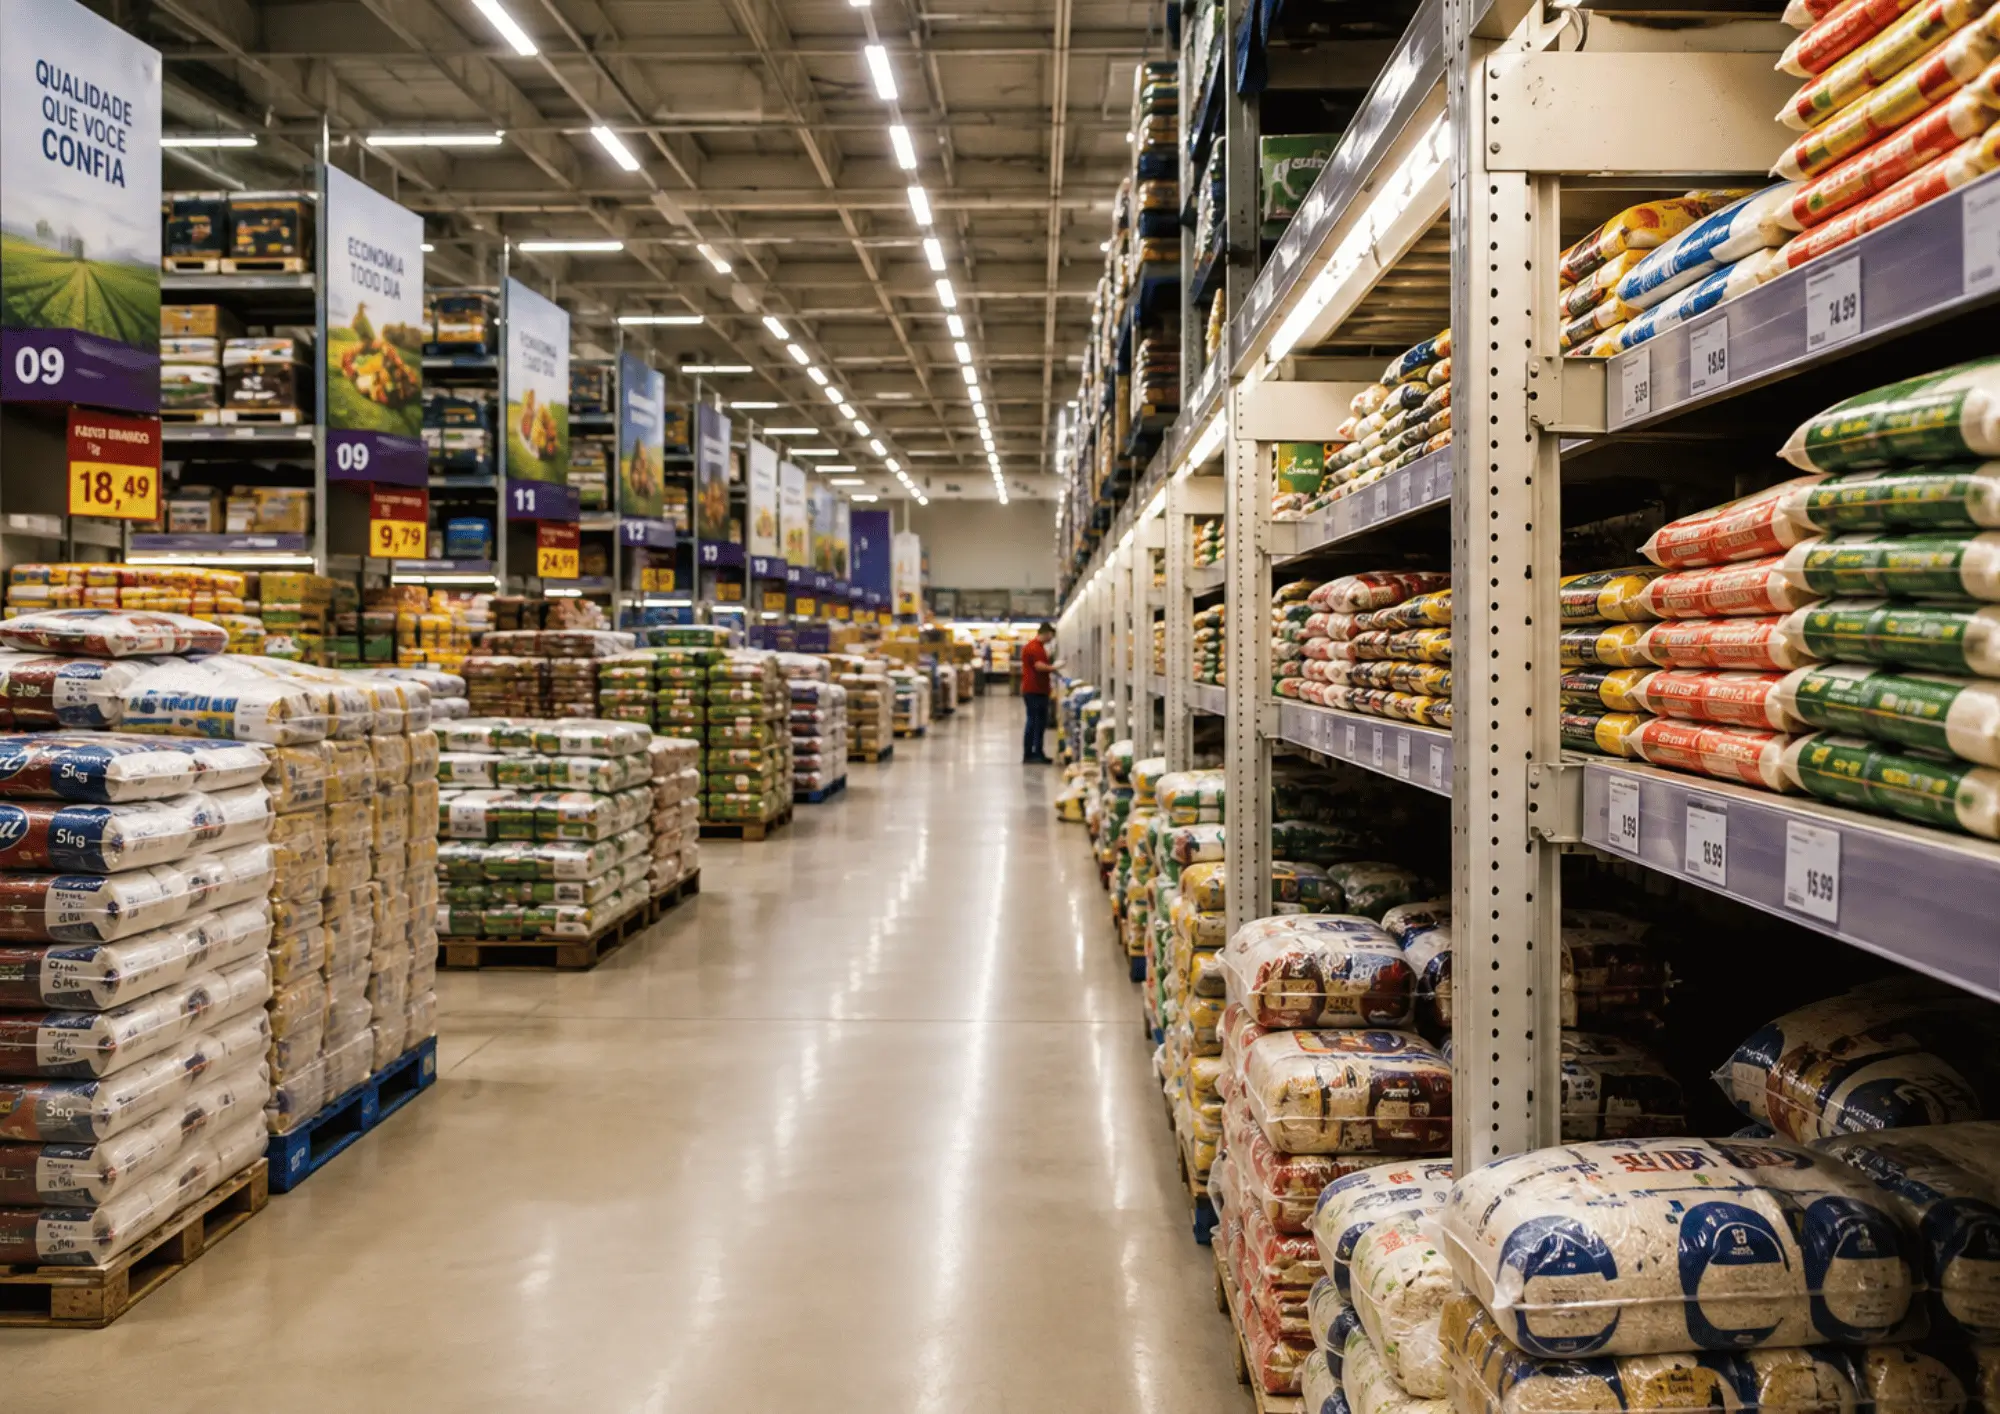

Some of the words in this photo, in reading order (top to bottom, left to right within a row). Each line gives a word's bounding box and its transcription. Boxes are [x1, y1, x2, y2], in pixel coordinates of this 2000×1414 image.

[36, 59, 132, 127] QUALIDADE
[42, 95, 78, 132] QUE
[83, 112, 126, 153] VOCE
[42, 128, 125, 188] CONFIA
[15, 346, 65, 385] 09
[336, 442, 370, 471] 09
[80, 470, 149, 511] 18,49
[514, 488, 535, 512] 11
[380, 524, 421, 552] 9,79
